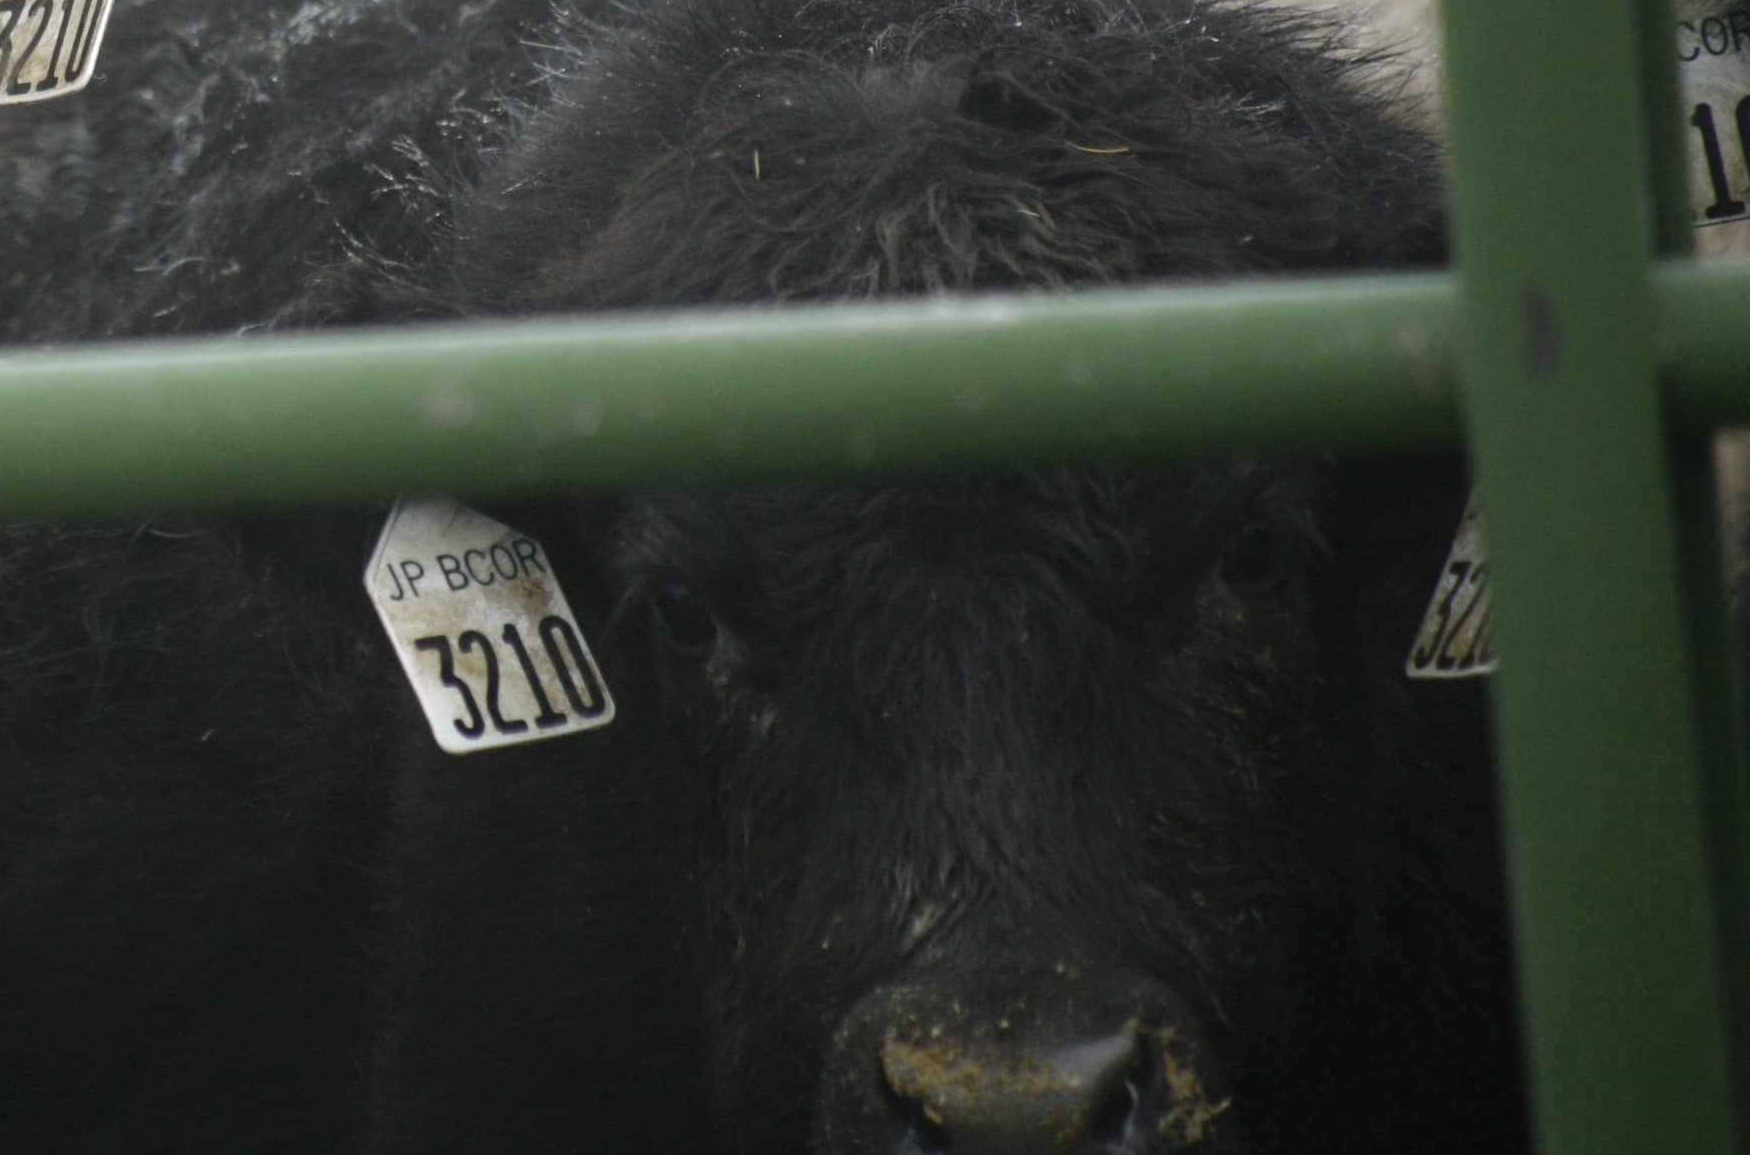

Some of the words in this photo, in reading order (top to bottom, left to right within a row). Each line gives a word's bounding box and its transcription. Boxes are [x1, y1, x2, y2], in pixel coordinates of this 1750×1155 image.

[1674, 9, 1750, 63] COR
[386, 560, 425, 602] JP
[436, 539, 546, 592] BCOR
[414, 615, 606, 740] 3210
